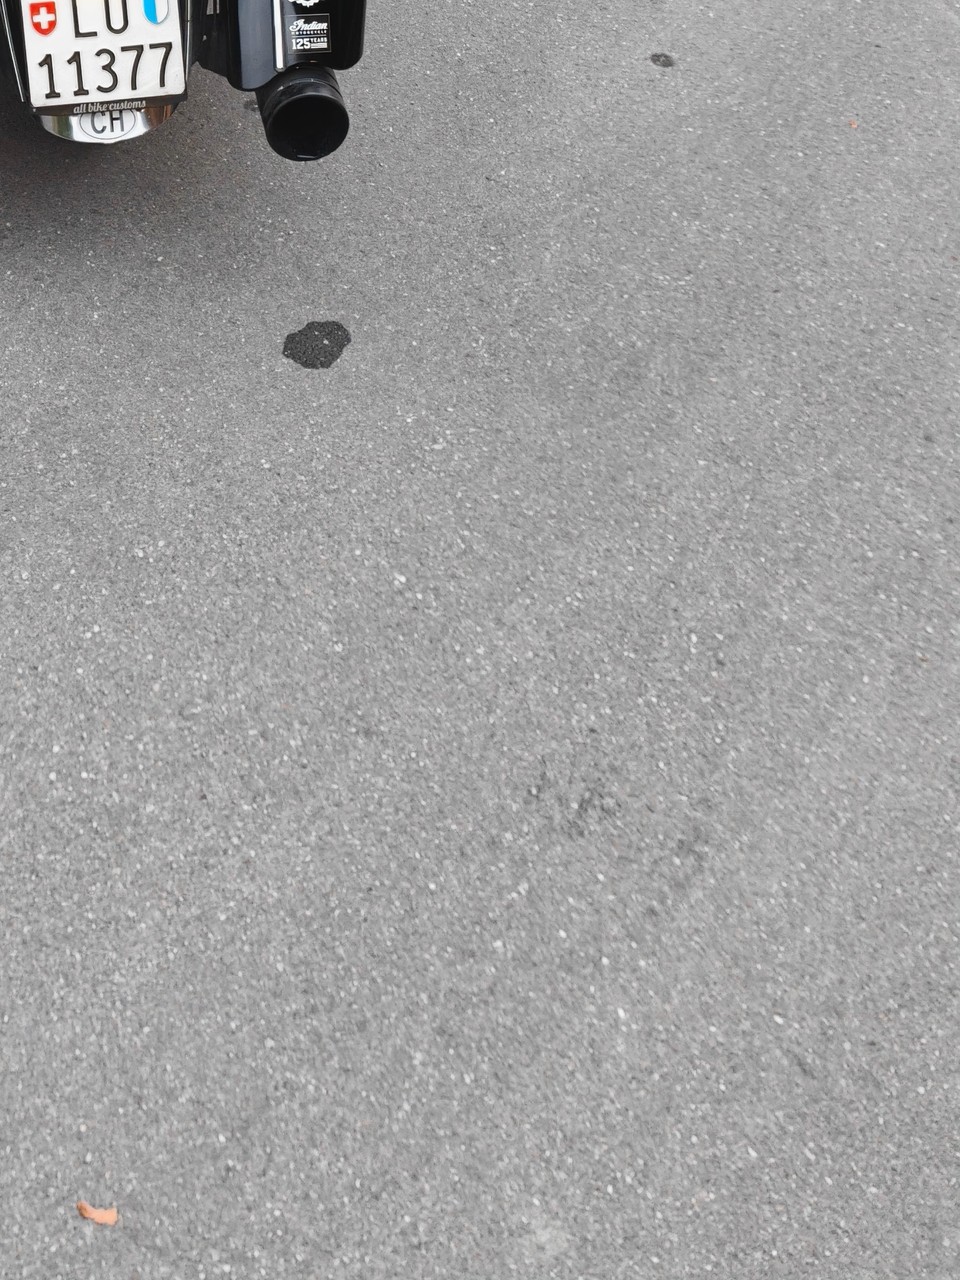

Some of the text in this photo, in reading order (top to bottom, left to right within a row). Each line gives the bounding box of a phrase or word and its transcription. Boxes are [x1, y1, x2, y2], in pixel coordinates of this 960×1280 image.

[289, 19, 328, 31] Indian
[292, 38, 311, 50] 125
[38, 41, 173, 99] 11377
[73, 100, 146, 114] all bike customs
[91, 110, 125, 134] CH
